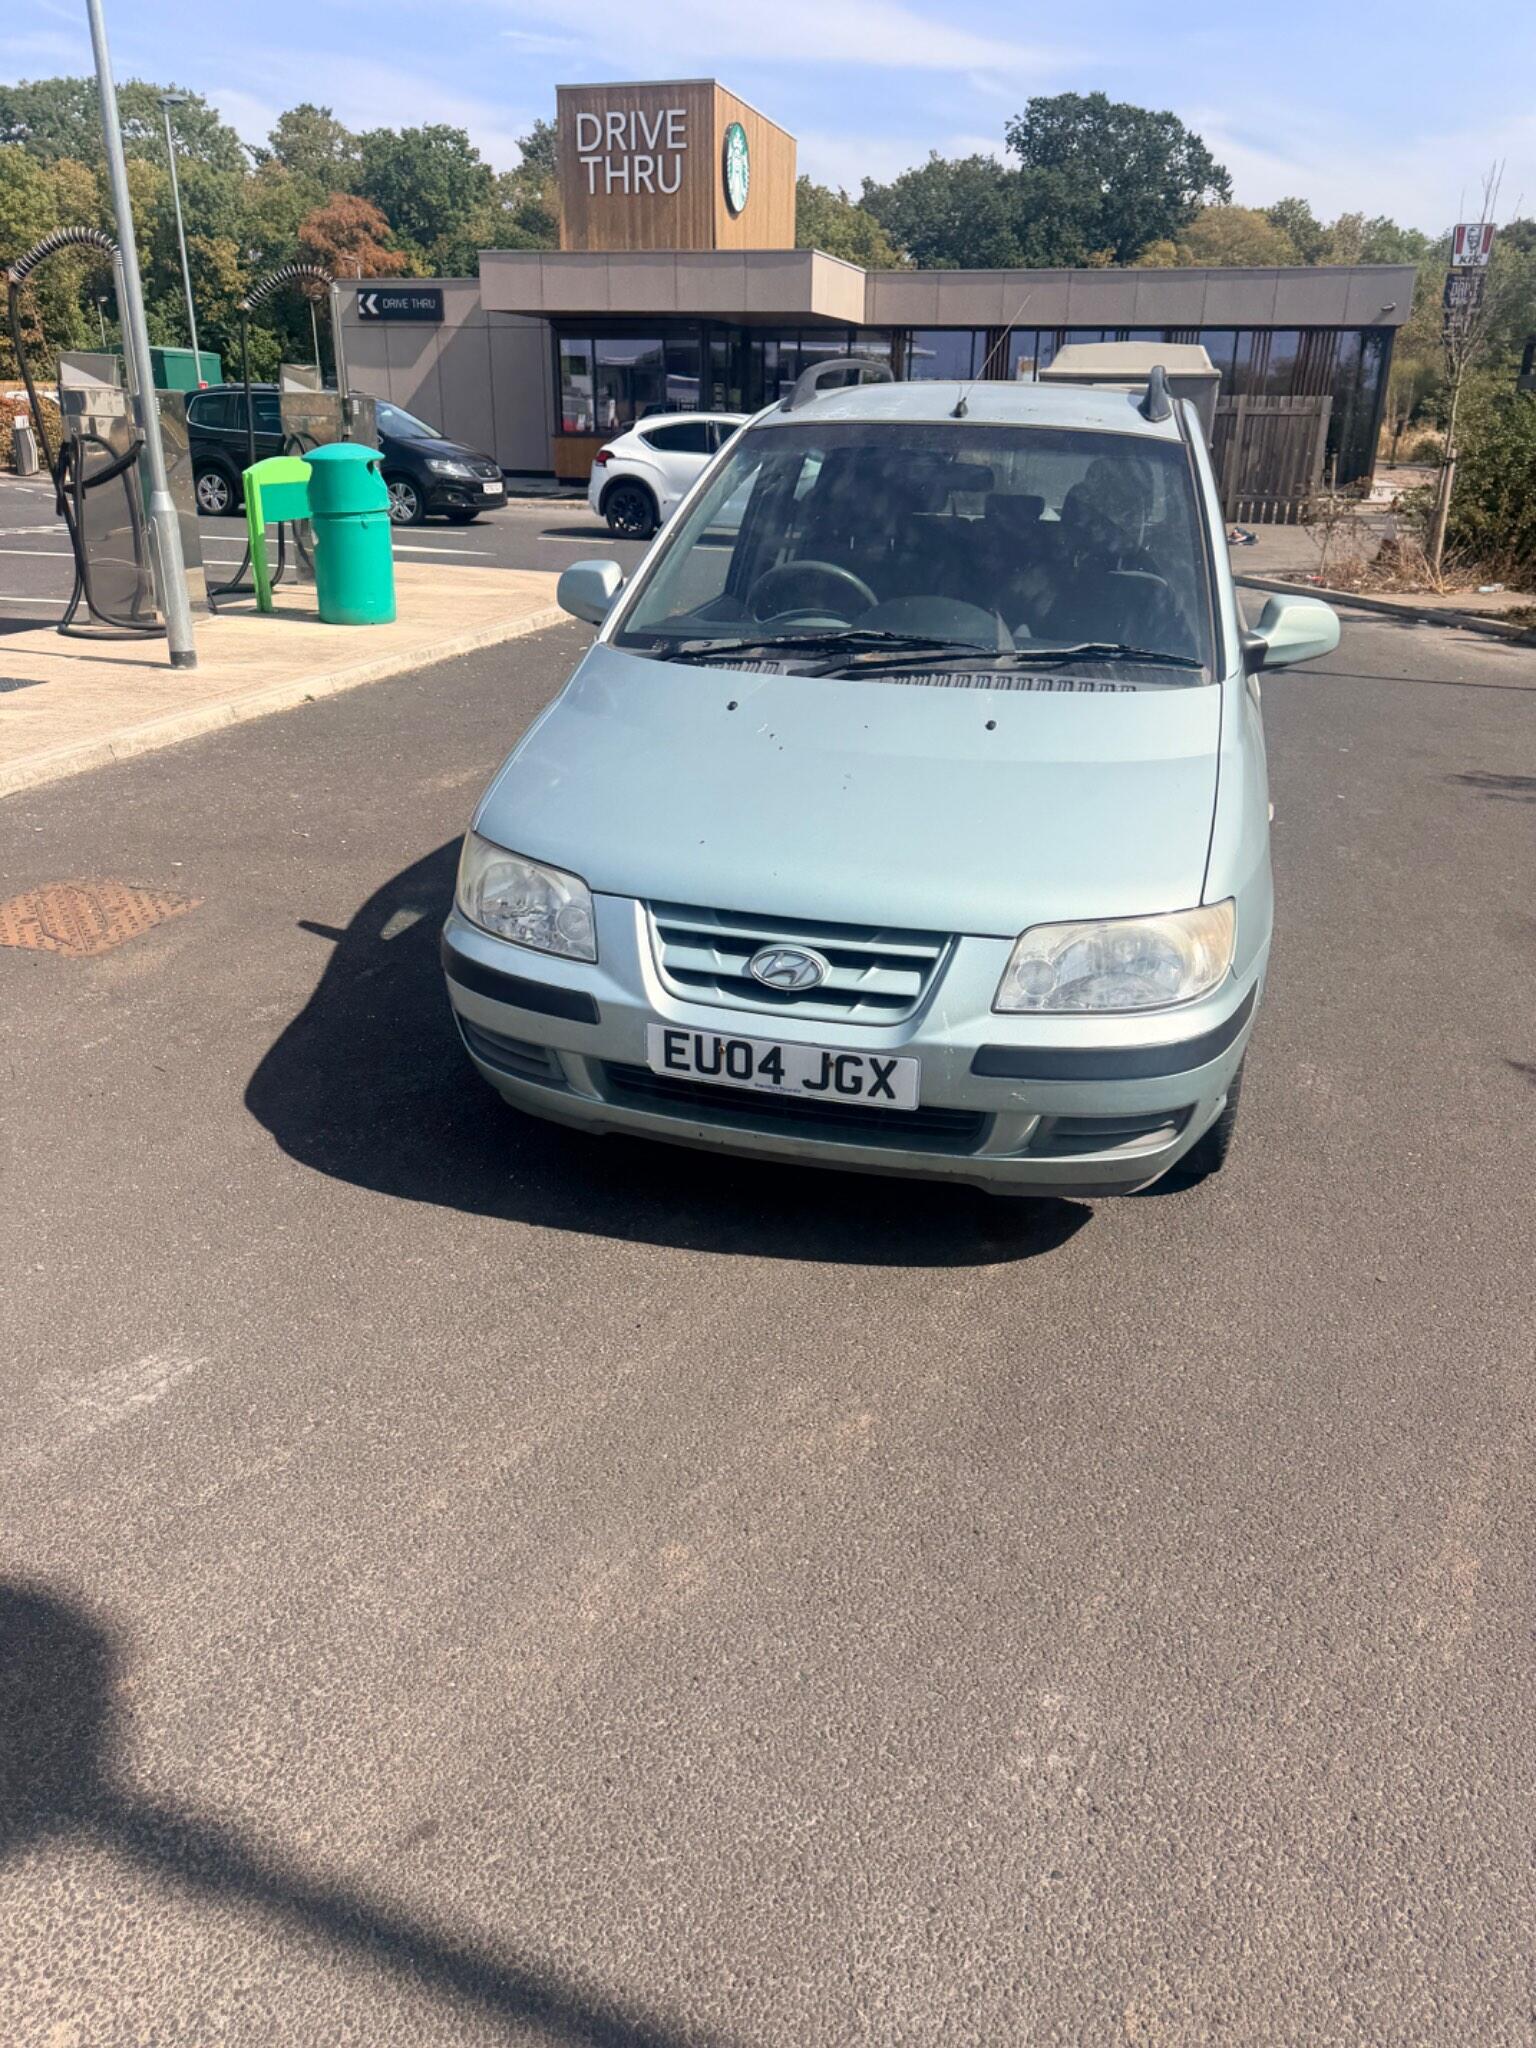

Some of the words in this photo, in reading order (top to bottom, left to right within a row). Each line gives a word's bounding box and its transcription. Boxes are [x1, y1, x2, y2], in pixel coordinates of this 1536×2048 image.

[575, 109, 687, 152] DRIVE
[579, 154, 681, 194] THRU
[1458, 255, 1483, 265] KFC
[382, 298, 409, 309] DRIVE
[412, 298, 436, 309] THRU
[664, 1029, 785, 1085] EU04
[802, 1051, 898, 1099] JGX
